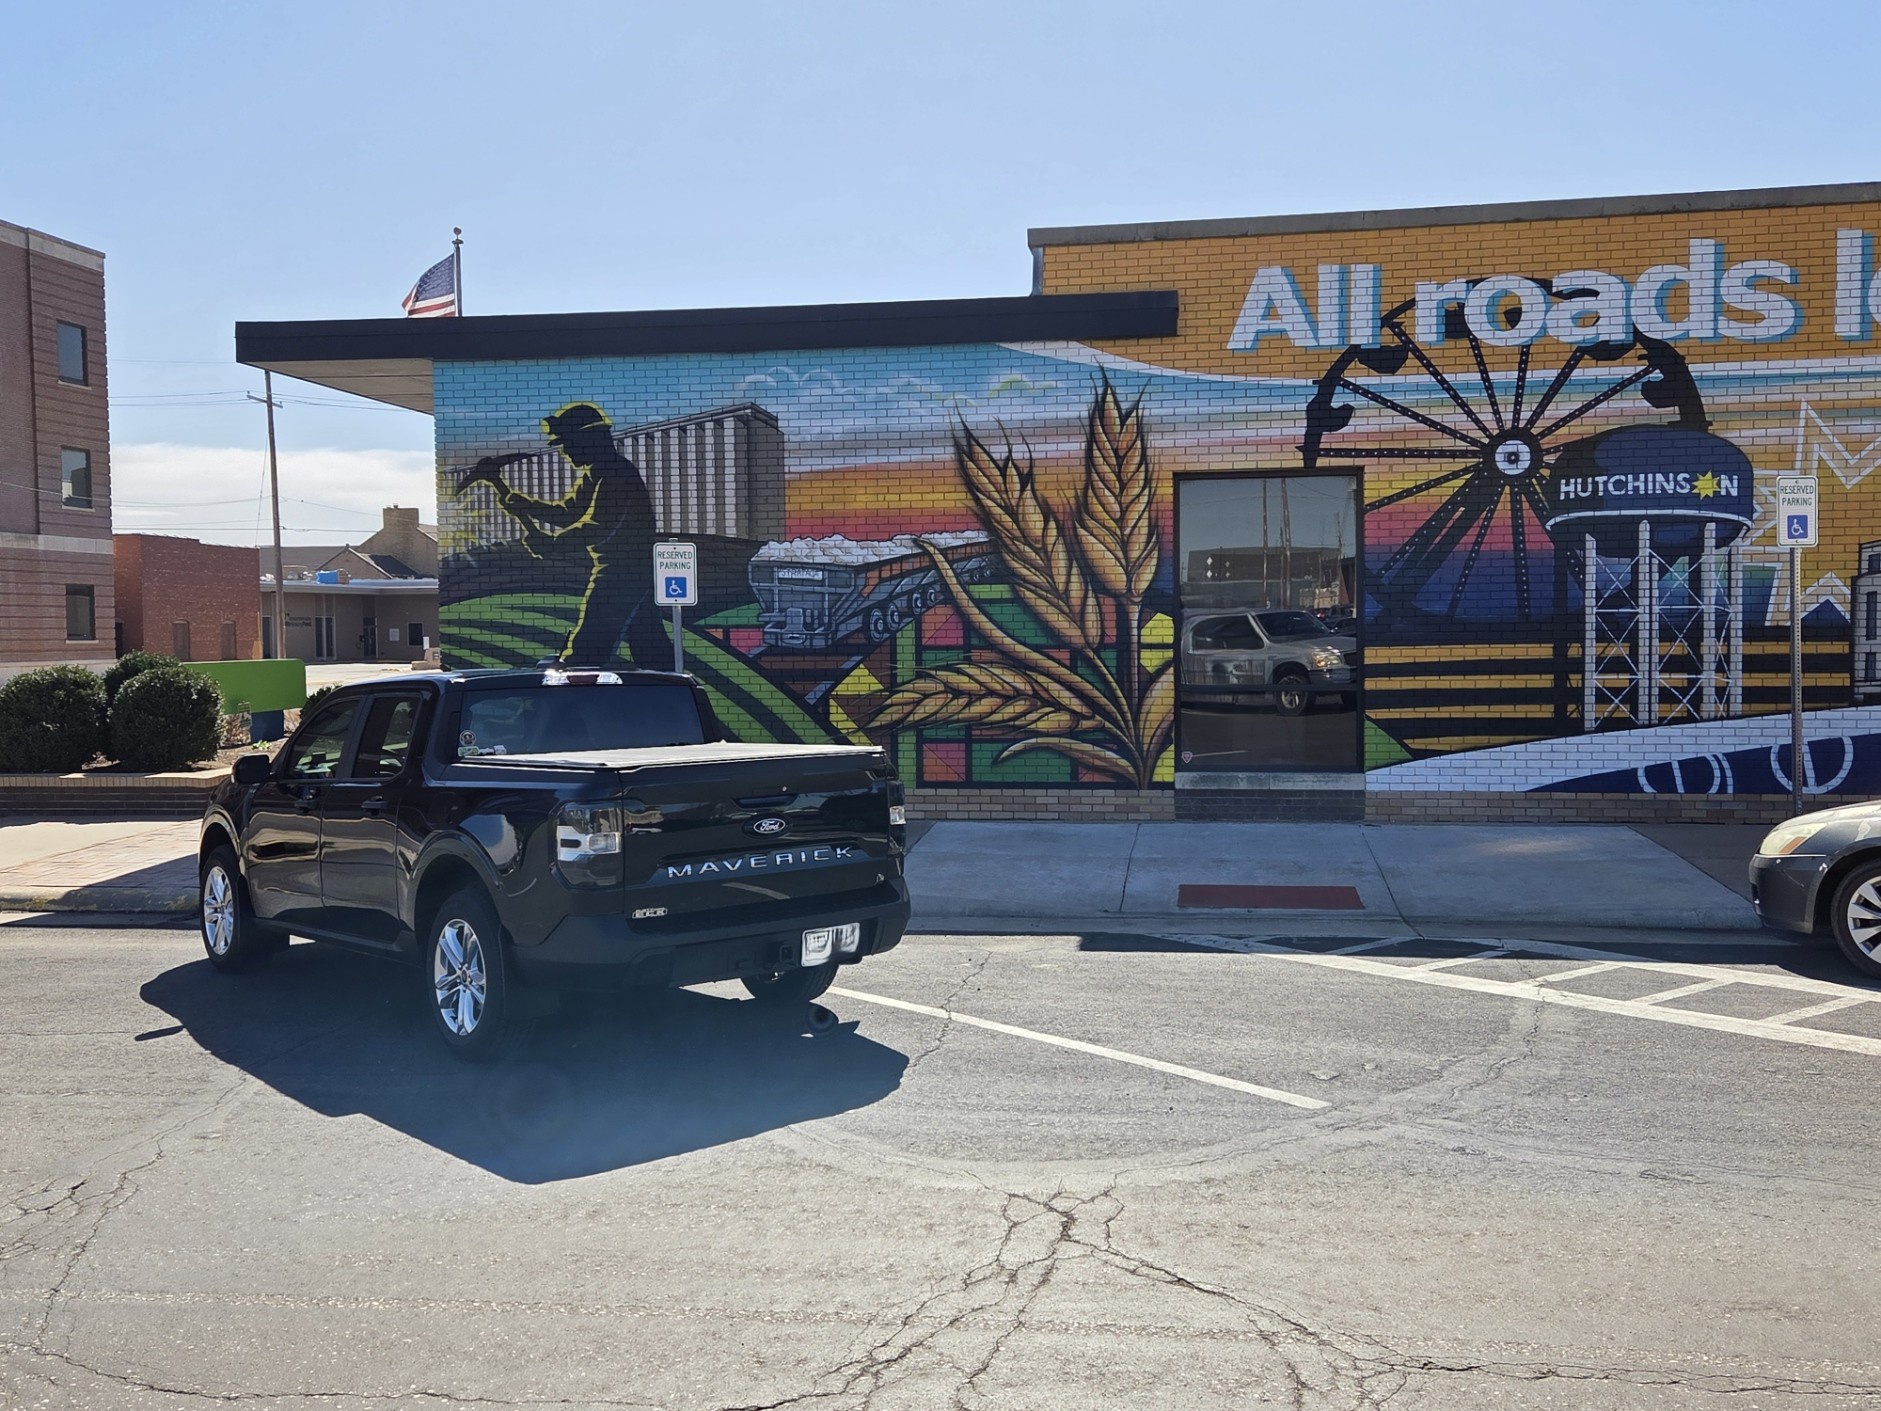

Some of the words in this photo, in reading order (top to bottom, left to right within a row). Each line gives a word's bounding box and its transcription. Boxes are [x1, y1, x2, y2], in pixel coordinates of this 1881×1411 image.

[1226, 263, 1382, 352] All
[1414, 238, 1804, 346] roads
[1559, 470, 1739, 500] HUTCHINSN
[1780, 484, 1814, 495] RESERVED
[1781, 496, 1812, 506] PARKING
[657, 550, 693, 560] RESERVED
[659, 561, 691, 570] PARKING
[758, 819, 782, 832] Ford
[667, 846, 852, 878] MAVERICK
